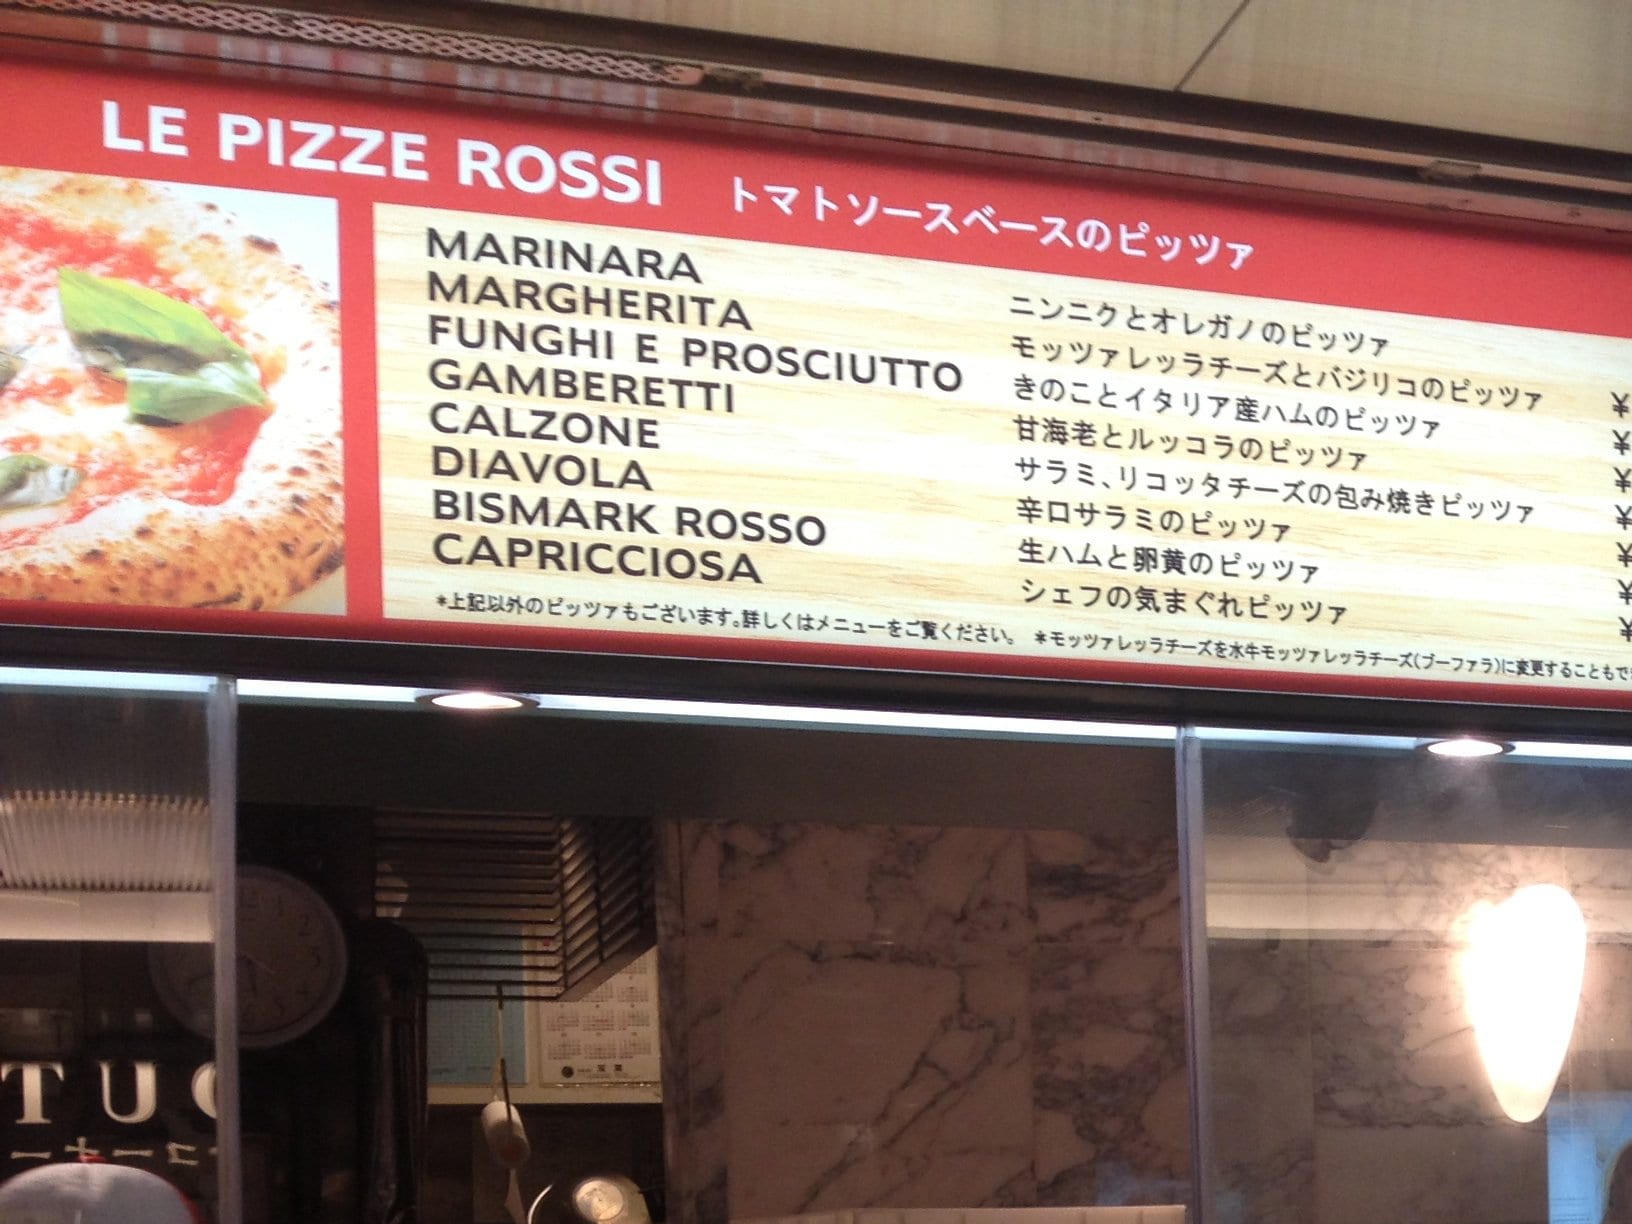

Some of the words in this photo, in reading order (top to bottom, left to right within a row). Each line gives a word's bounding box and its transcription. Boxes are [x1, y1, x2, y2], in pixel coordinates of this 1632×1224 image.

[102, 100, 190, 158] LE
[218, 113, 429, 182] PIZZE
[458, 138, 664, 207] ROSSI
[731, 176, 1255, 272] トマトソースベースのピッツァ
[427, 226, 703, 285] MARINARA
[427, 272, 754, 332] MARGHERITA
[1009, 295, 1390, 357] ニンニクとオレガノのピッツァ
[428, 314, 616, 364] FUNGHI
[636, 331, 659, 365] E
[683, 337, 964, 393] PROSCIUTTO
[1010, 334, 1544, 412] モッツァレッラチーズとバジリコのピッツァ
[428, 357, 736, 415] GAMBERETTI
[1012, 372, 1441, 441] きのことイタリア産ハムのピッツァ
[428, 401, 661, 450] CALZONE
[1012, 414, 1368, 472] 甘海老とルッコラのピッツァ
[431, 444, 654, 492] DIAVOLA
[1014, 456, 1535, 527] サラミ、リコッタチーズの包み焼きピッツァ
[432, 488, 660, 537] BISMARK
[676, 506, 828, 547] ROSSO
[1016, 495, 1293, 546] 辛口サラミのピッツァ
[432, 532, 764, 586] CAPRICCIOSA
[1018, 537, 1321, 587] 生ハムと卵黄のピッツァ
[1021, 577, 1348, 628] シェフの気まぐれピッツァ
